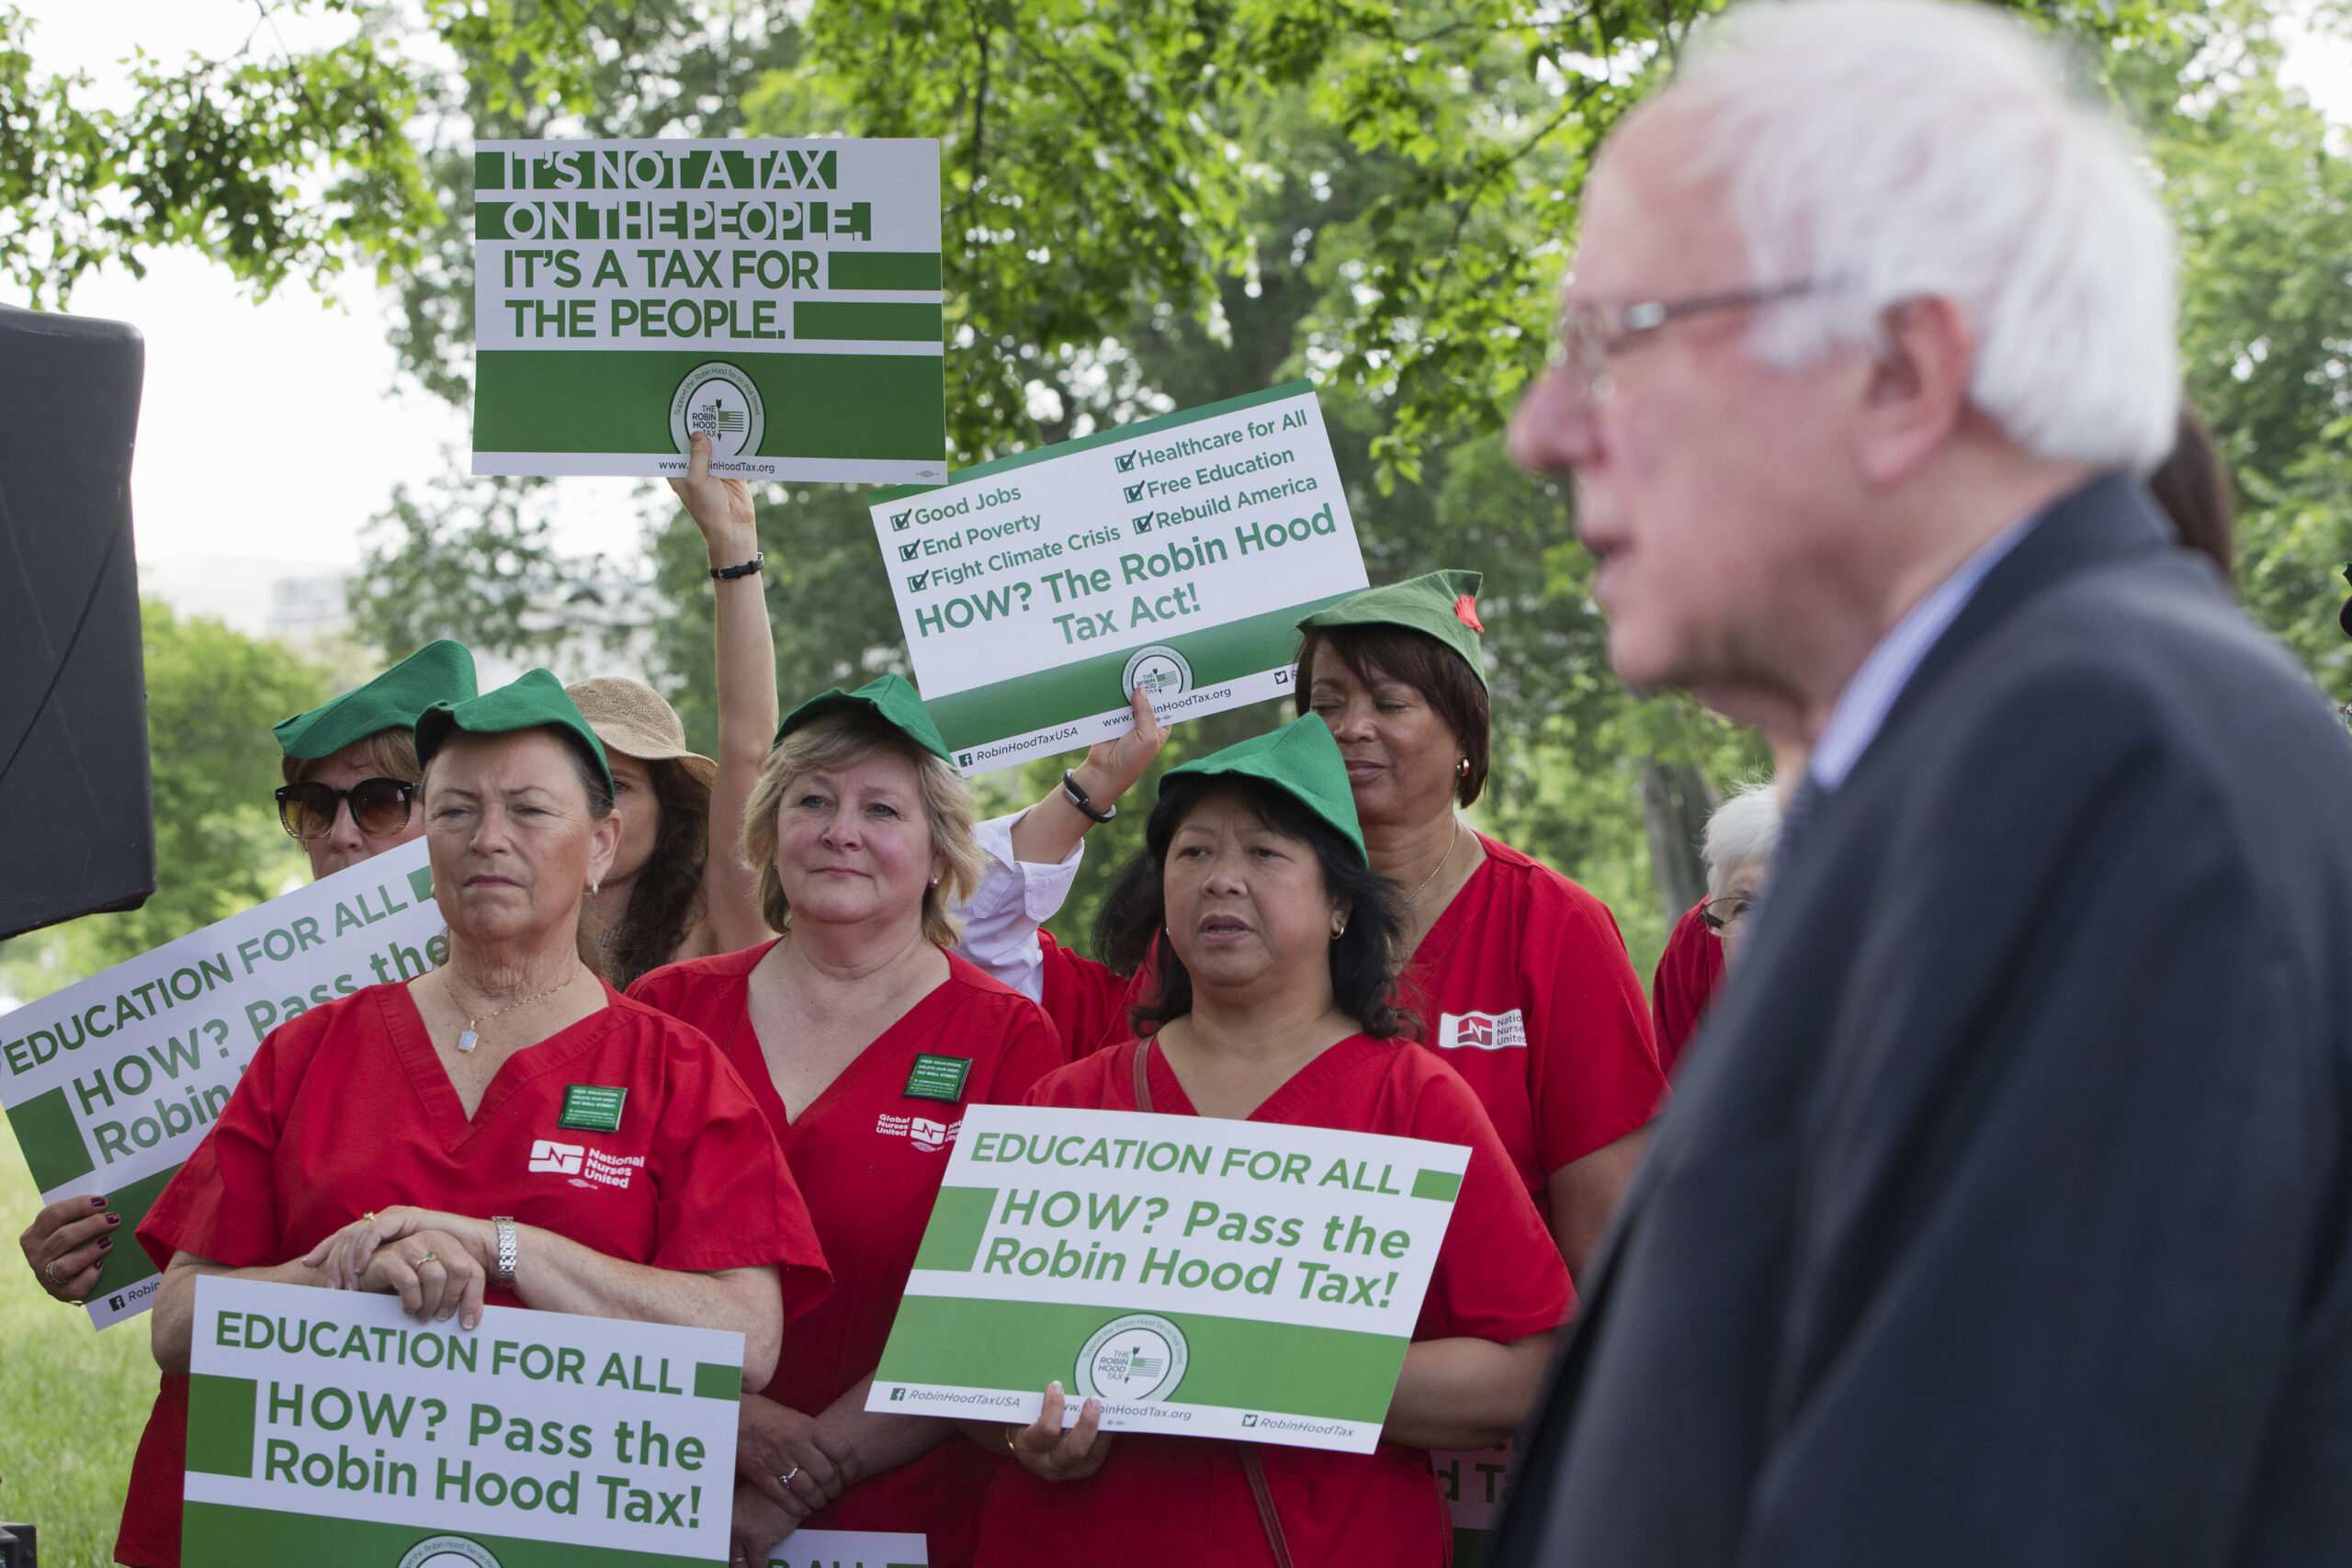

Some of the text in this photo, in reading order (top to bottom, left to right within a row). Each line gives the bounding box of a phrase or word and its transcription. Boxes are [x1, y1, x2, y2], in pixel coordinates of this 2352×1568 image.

[504, 151, 829, 189] IT'S NOT A TAX
[504, 201, 576, 240] ON
[588, 201, 678, 240] THE
[504, 249, 820, 289] IT'S A TAX FOR
[504, 299, 786, 339] THE PEOPLE.
[695, 368, 711, 380] Robin
[728, 369, 737, 380] Tax
[692, 412, 717, 421] ROBIN
[1138, 409, 1307, 468] Healthcare for All
[659, 461, 775, 474] www.inHoodTax.org
[1147, 449, 1295, 498] Free Education
[914, 488, 1022, 525] Good Jobs
[1155, 477, 1317, 529] Rebuild America
[922, 514, 1041, 556] End Poverty
[915, 502, 1337, 637] HOW? The Robin Hood
[931, 525, 1121, 587] Fight Climate Crisis
[1052, 581, 1201, 644] Tax Act!
[977, 727, 1079, 761] RobinHoodTaxUSA
[3, 884, 409, 1076] EDUCATION FOR ALL
[73, 1019, 230, 1116] HOW?
[369, 934, 450, 985] the
[92, 1084, 232, 1165] Robin
[876, 1126, 907, 1137] United
[877, 1120, 909, 1130] Nurses
[879, 1113, 910, 1123] Global
[586, 1157, 632, 1177] Nurses
[589, 1147, 645, 1168] National
[970, 1133, 1401, 1195] EDUCATION FOR ALL
[584, 1168, 629, 1189] United
[999, 1189, 1410, 1258] HOW? Pass the
[983, 1237, 1399, 1308] Robin Hood Tax!
[217, 1310, 683, 1395] EDUCATION FOR ALL
[1098, 1365, 1126, 1373] HOOD
[1100, 1357, 1129, 1366] ROBIN
[1114, 1350, 1131, 1359] THE
[1107, 1372, 1123, 1381] TAX
[910, 1390, 1021, 1407] RobinHoodTaxUSA
[268, 1381, 706, 1471] HOW? Pass the
[1260, 1417, 1356, 1437] RobinHoodTax
[265, 1438, 702, 1529] Robin Hood Tax!
